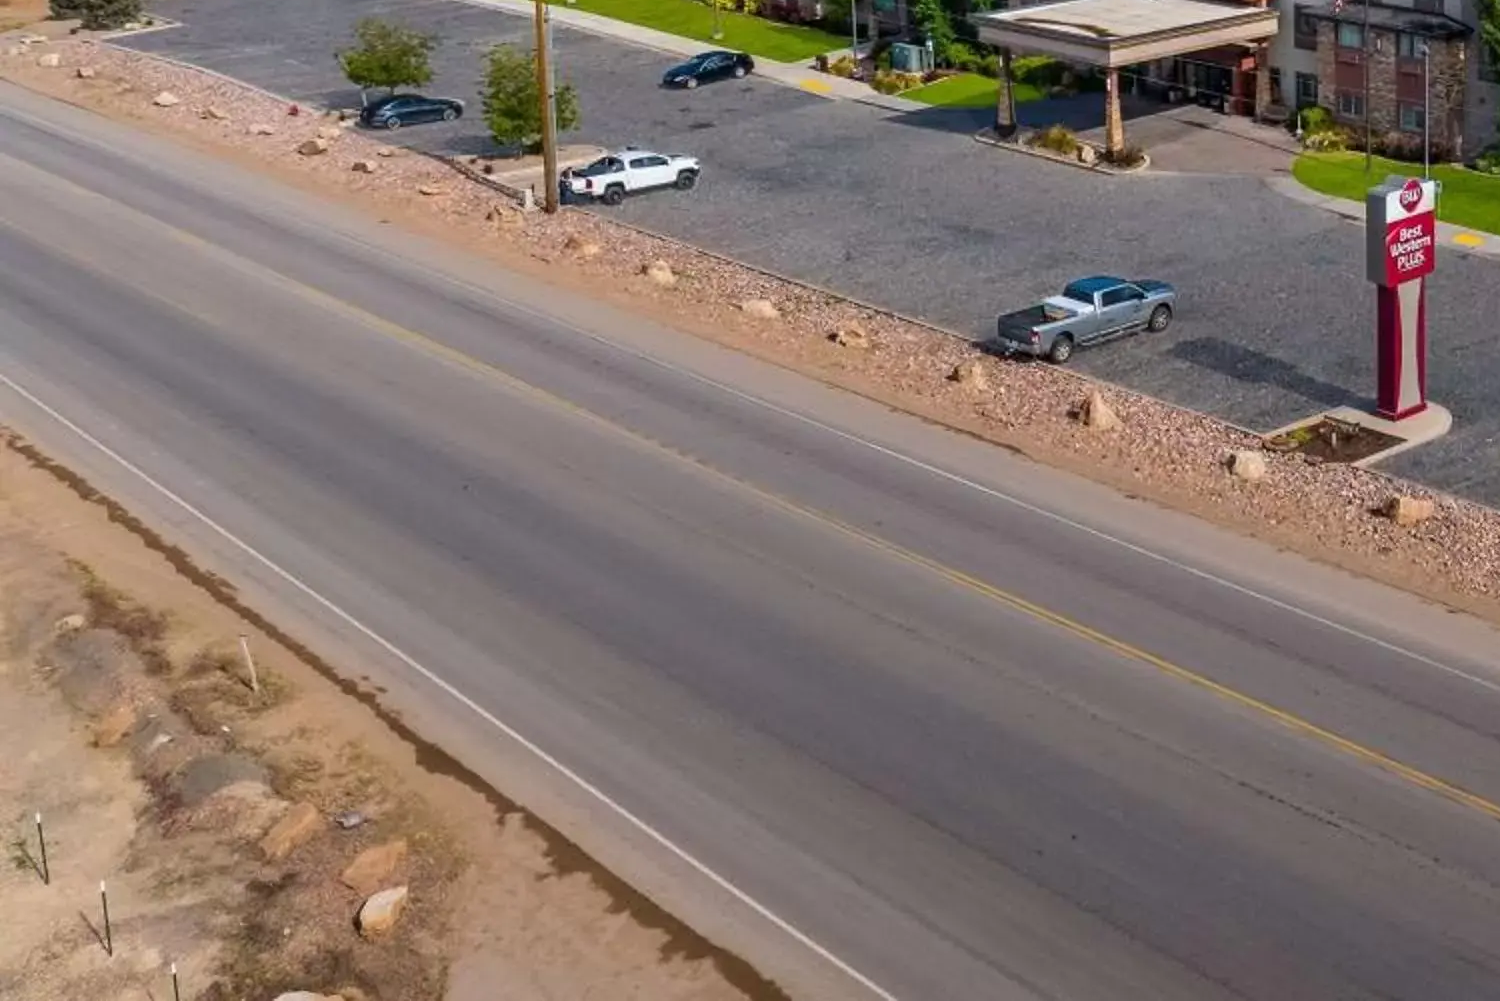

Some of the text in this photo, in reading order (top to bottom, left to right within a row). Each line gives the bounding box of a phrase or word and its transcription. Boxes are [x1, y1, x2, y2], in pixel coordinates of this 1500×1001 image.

[1400, 225, 1422, 242] Best
[1390, 236, 1431, 257] Western
[1398, 250, 1425, 273] PLUS
